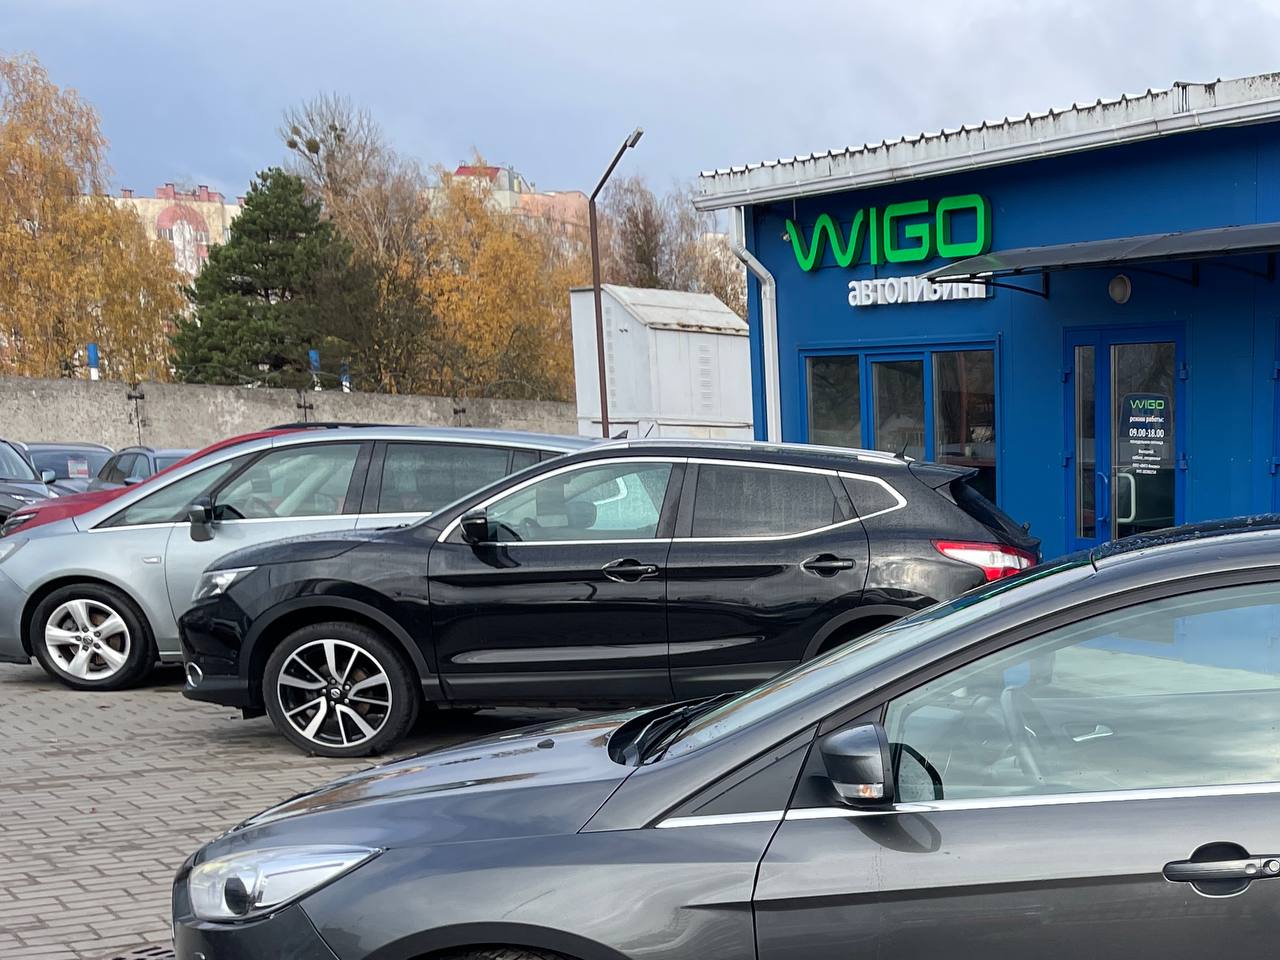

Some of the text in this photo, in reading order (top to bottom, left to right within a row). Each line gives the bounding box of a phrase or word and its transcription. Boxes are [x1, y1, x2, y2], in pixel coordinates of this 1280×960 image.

[785, 193, 991, 272] WIGO
[1130, 400, 1165, 409] WIGO
[1129, 428, 1165, 438] 09.00-18.00
